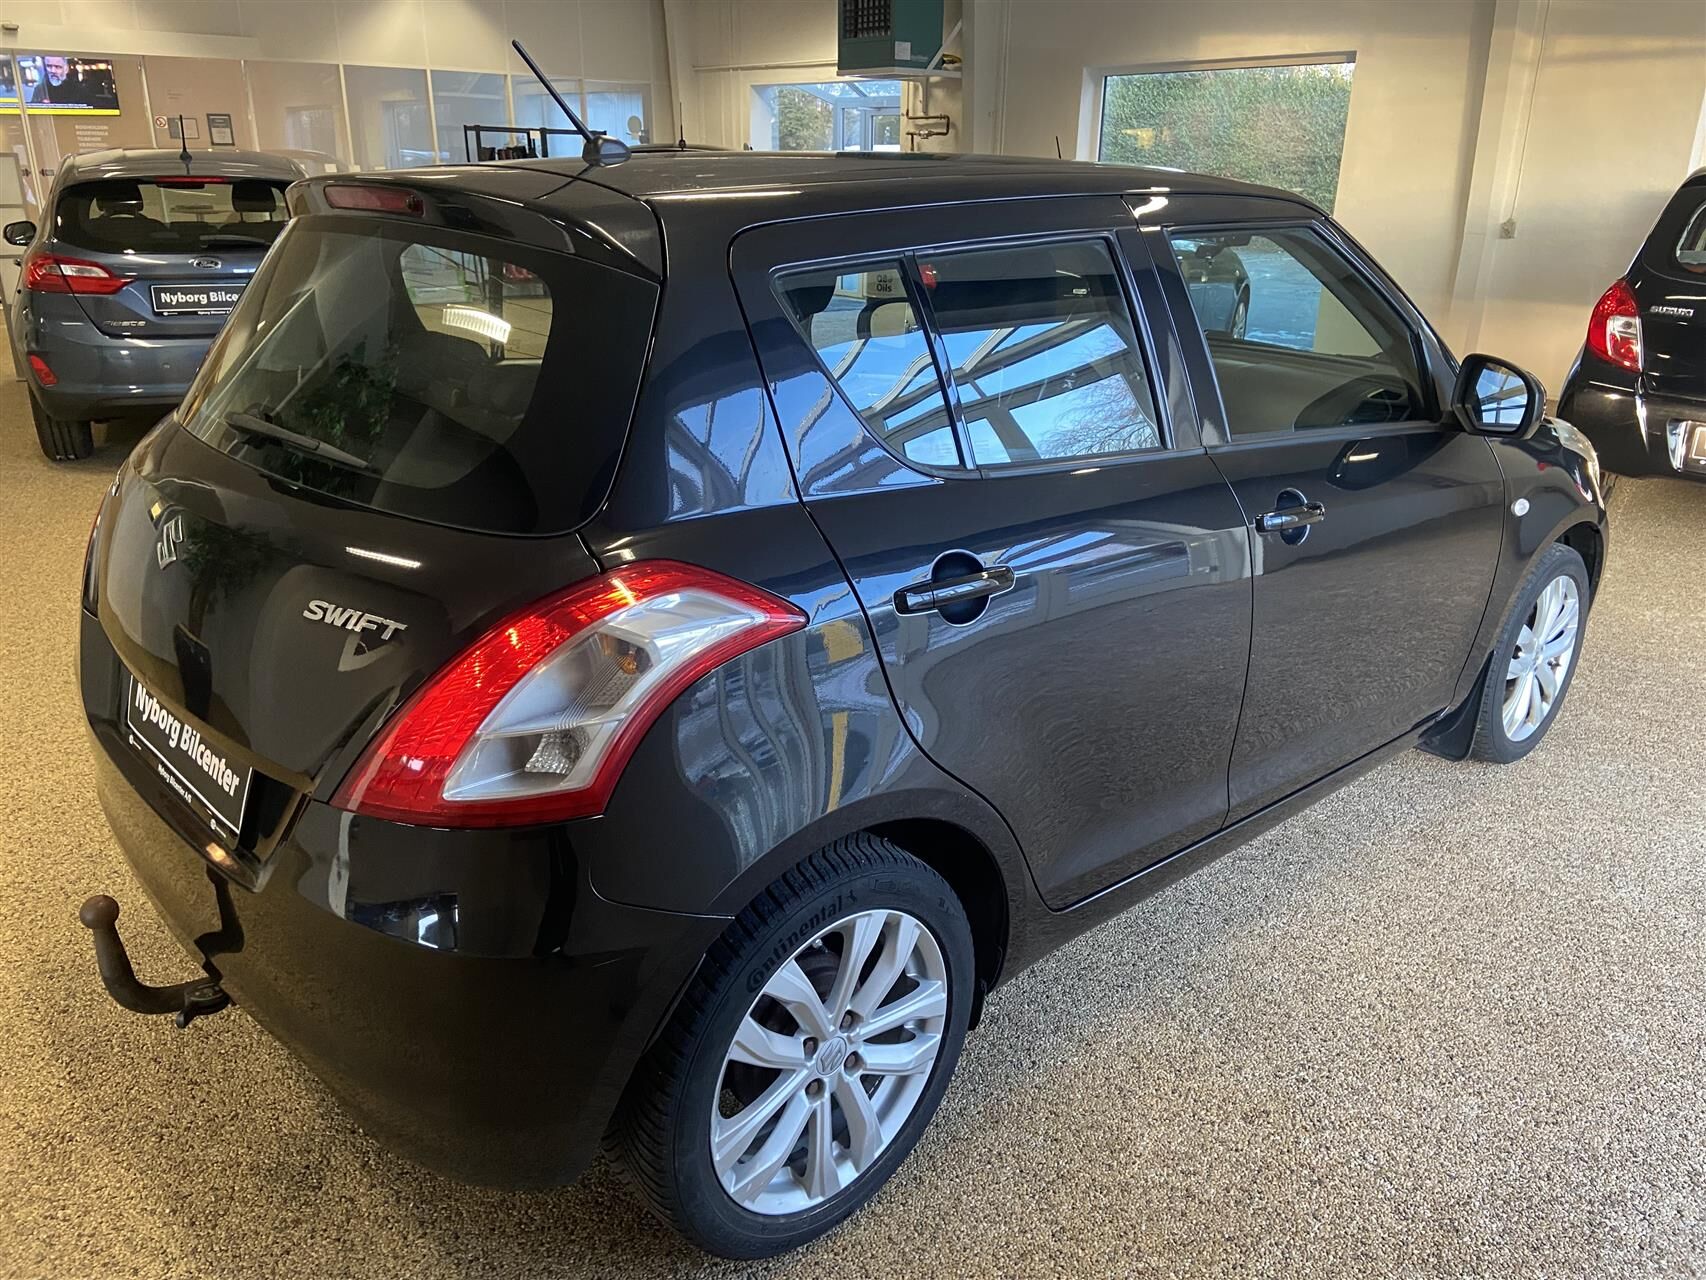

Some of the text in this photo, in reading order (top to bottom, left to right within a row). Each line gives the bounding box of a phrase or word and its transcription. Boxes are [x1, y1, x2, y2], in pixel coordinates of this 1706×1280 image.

[160, 291, 240, 306] Nyborg Bilce
[876, 283, 892, 293] Oils
[1650, 305, 1695, 317] SUZUKI
[302, 599, 408, 640] SWIFT
[135, 682, 240, 797] Nyborg Bilcenter
[745, 897, 844, 993] Continental
